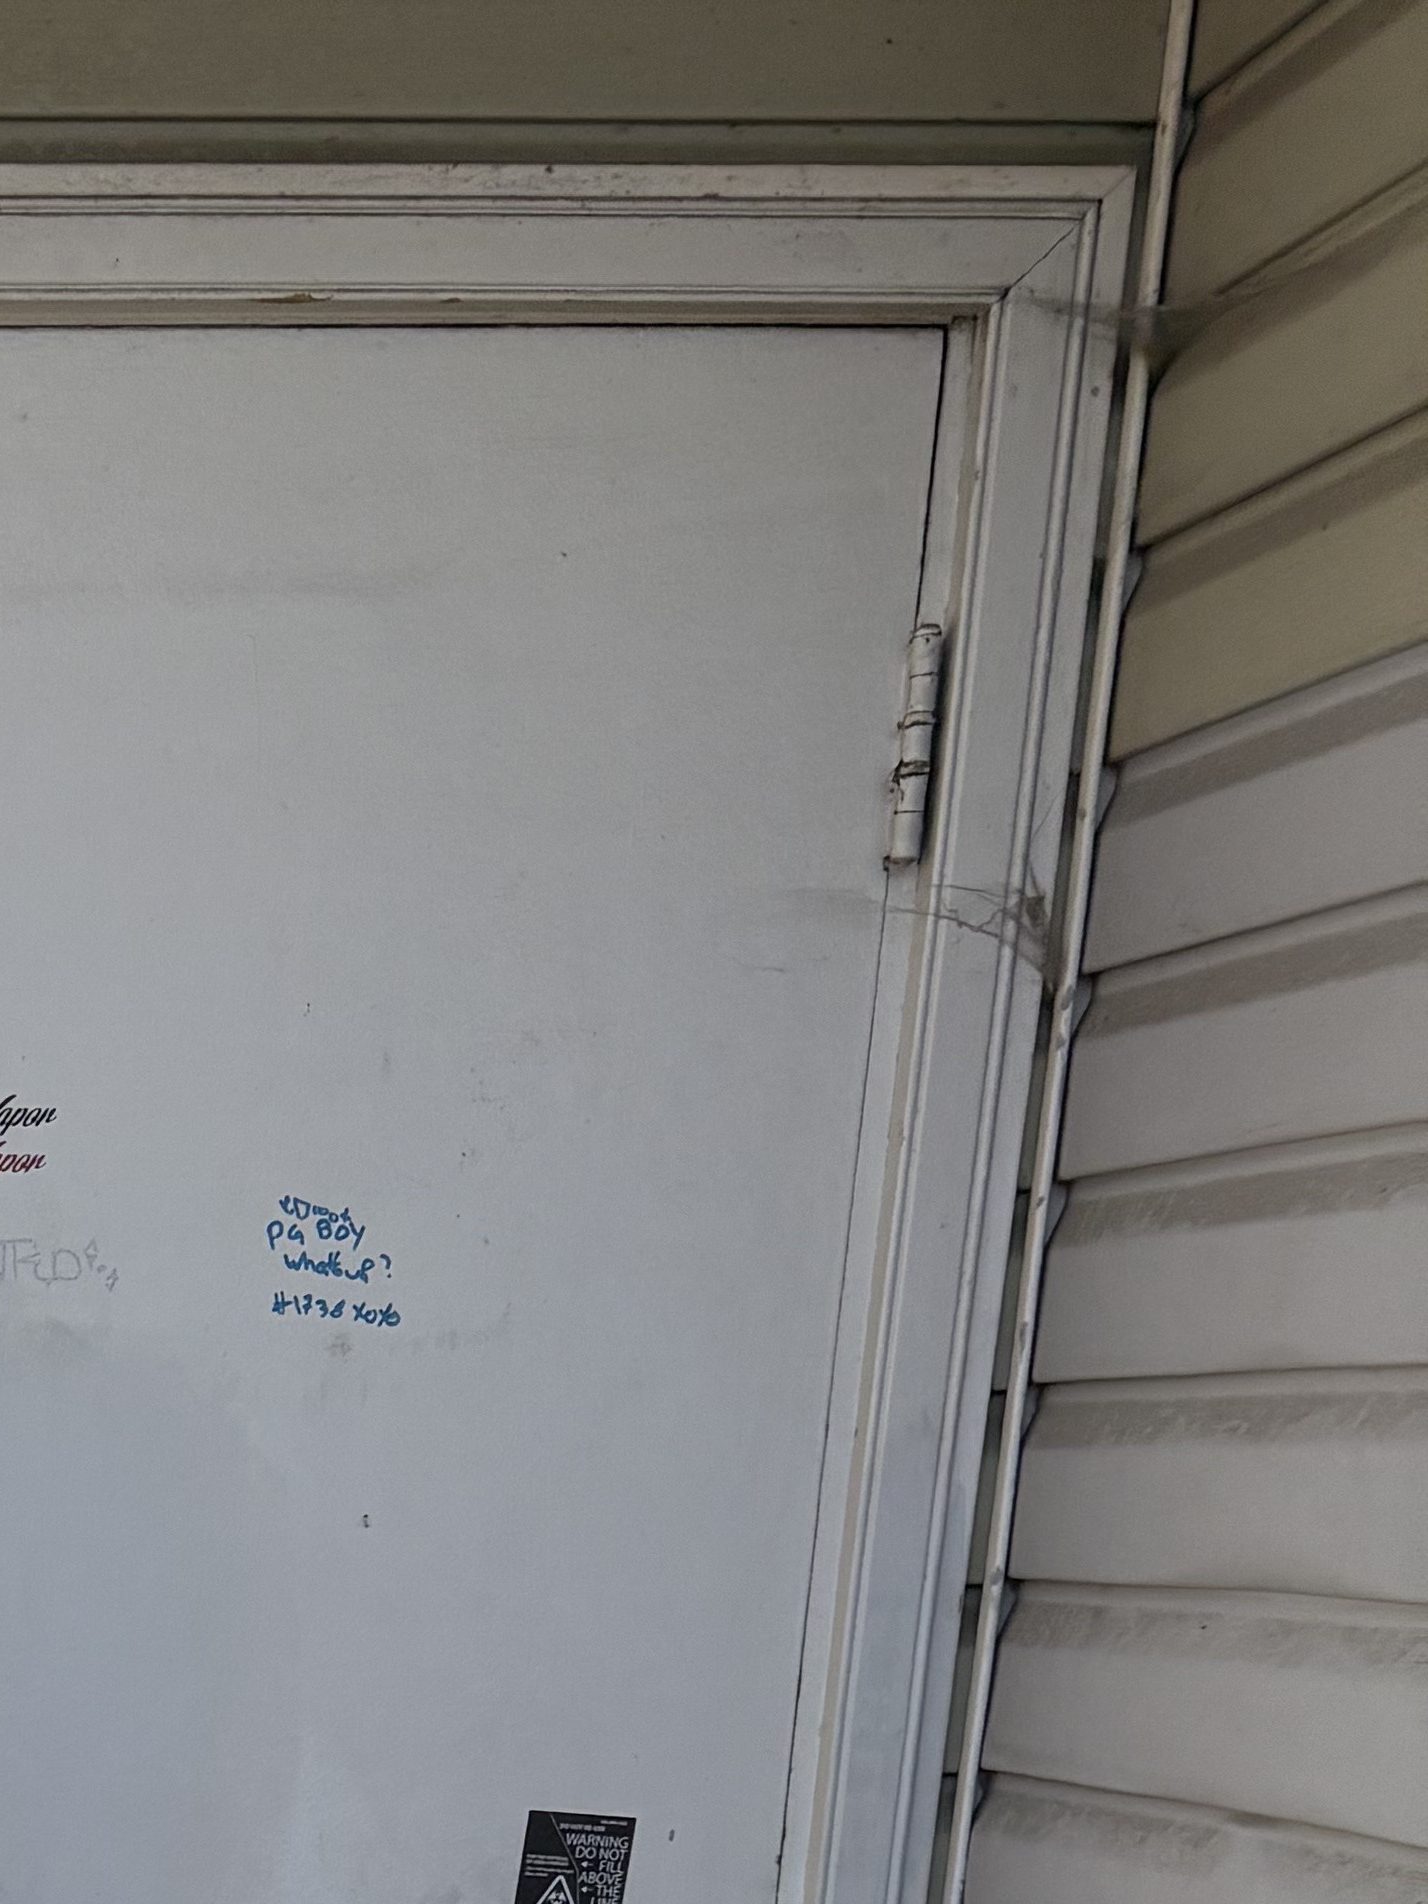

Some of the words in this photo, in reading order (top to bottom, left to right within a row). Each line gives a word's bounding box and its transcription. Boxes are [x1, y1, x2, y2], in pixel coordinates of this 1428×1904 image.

[566, 1833, 629, 1849] WARNING
[575, 1846, 597, 1859] DO
[598, 1848, 629, 1861] NOT
[599, 1860, 624, 1874] FILL
[578, 1871, 623, 1886] ABOVE
[595, 1884, 621, 1898] THE
